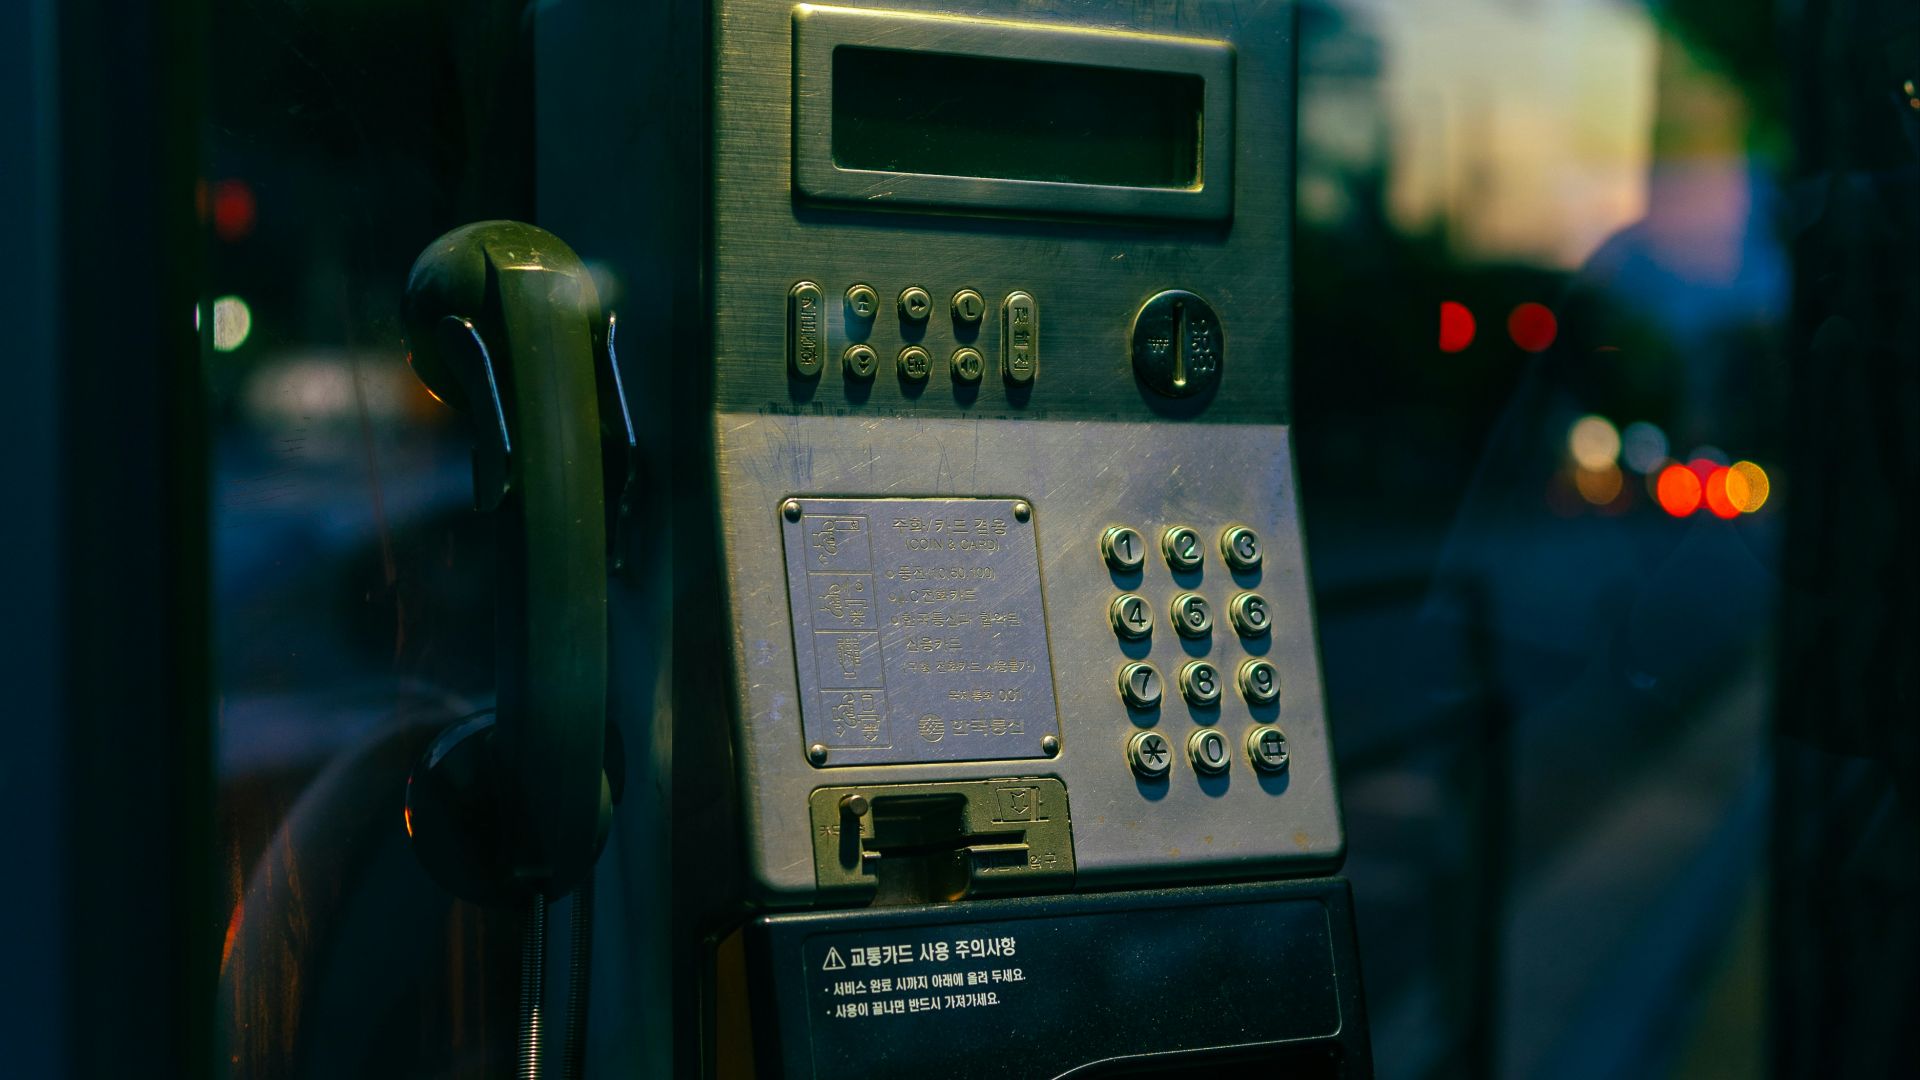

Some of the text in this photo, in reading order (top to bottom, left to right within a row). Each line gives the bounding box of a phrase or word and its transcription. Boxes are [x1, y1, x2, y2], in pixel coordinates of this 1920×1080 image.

[964, 299, 976, 318] L
[1014, 307, 1030, 371] 재발신
[1191, 319, 1209, 335] 10
[1191, 337, 1210, 353] 50
[1191, 355, 1216, 371] 100
[892, 517, 969, 535] 주화/카드
[905, 538, 1000, 552] (COIN & CARD)
[1120, 533, 1133, 560] 1
[1180, 532, 1199, 560] 2
[1240, 532, 1256, 559] 3
[1129, 601, 1147, 628] 4
[1189, 600, 1206, 627] 5
[1247, 598, 1266, 626] 6
[906, 636, 963, 653] 신용카드
[1136, 669, 1153, 697] 7
[1197, 667, 1215, 695] 8
[1255, 666, 1273, 693] 9
[1206, 735, 1223, 763] 0
[1263, 733, 1287, 761] #
[850, 936, 1016, 967] 교통카드 사용 주의사항
[833, 968, 1026, 996] 서비스 완료 시까지 아래에 올려 두세요.
[835, 992, 1001, 1019] 사용이 끝나면 반드시 가져가세요.
